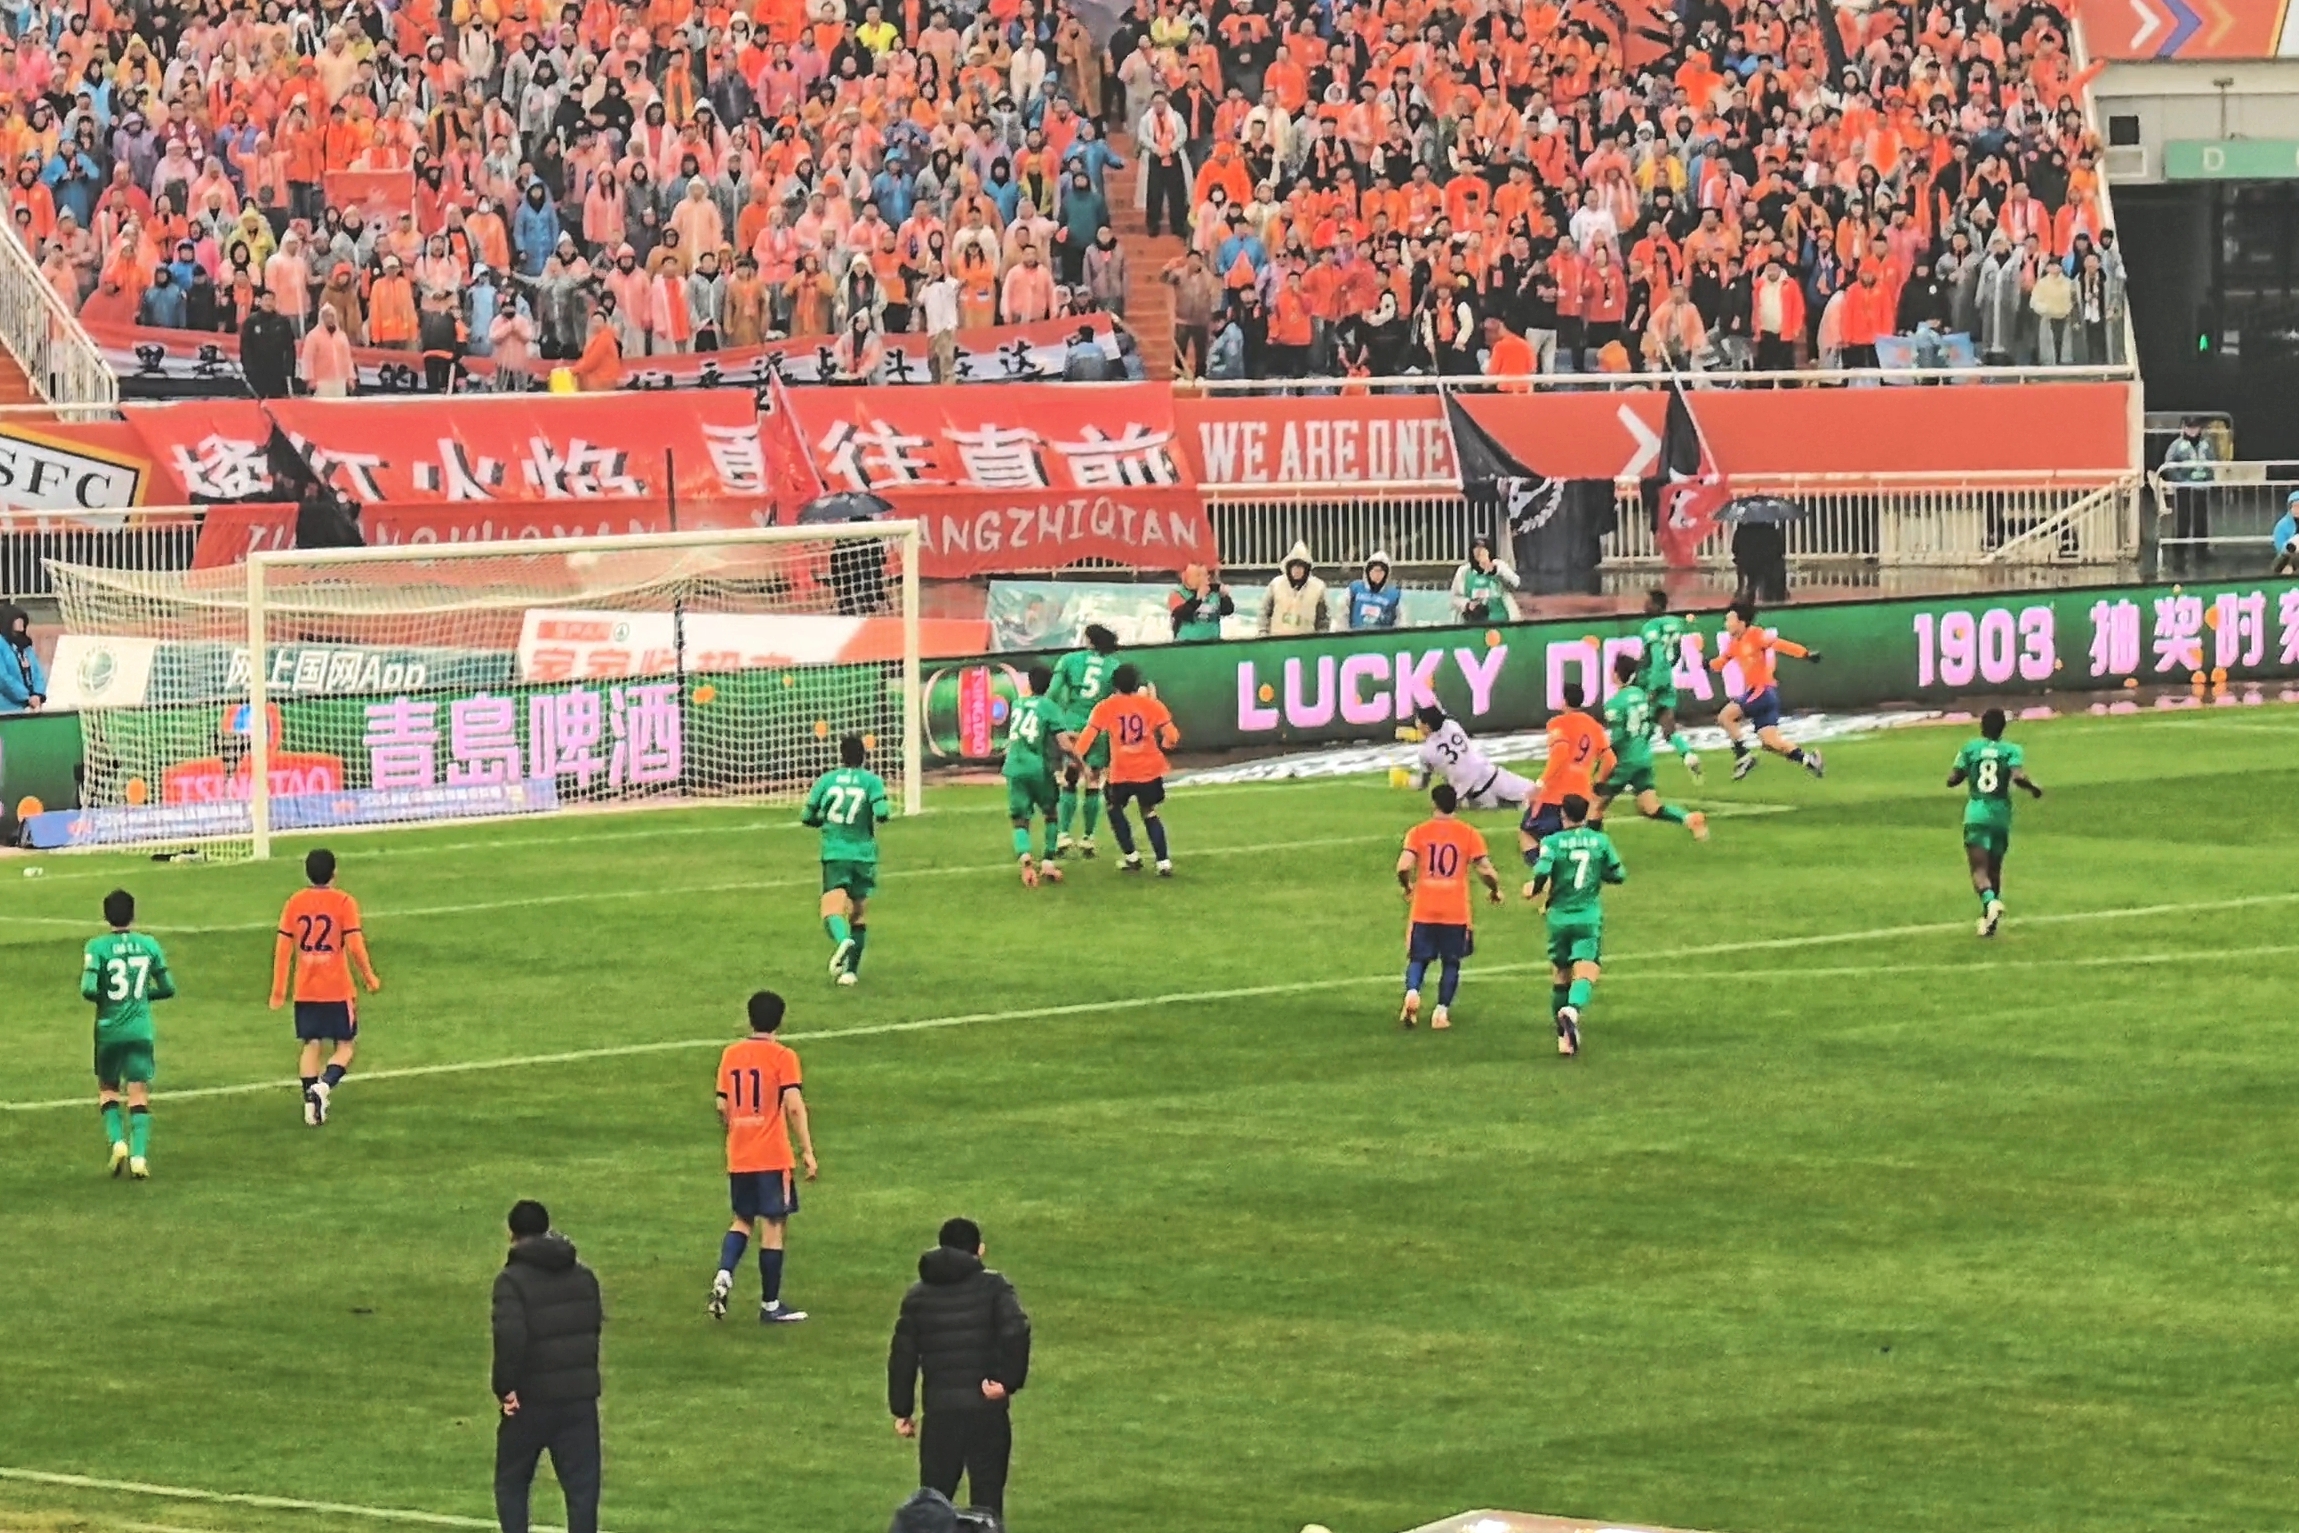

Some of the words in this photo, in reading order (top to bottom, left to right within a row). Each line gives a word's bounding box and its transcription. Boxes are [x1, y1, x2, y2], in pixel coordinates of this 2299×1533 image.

[2203, 146, 2225, 172] D
[1199, 421, 1268, 482] WE
[1277, 420, 1360, 481] ARE
[1366, 418, 1449, 480] ONE
[917, 497, 1200, 556] ANGZHIQIAN
[1079, 664, 1103, 699] 5
[1238, 645, 1508, 731] LUCKY
[1914, 606, 2055, 687] 1903
[362, 684, 681, 789] 青岛啤酒
[1009, 707, 1040, 744] 24
[1118, 713, 1144, 745] 19
[1436, 732, 1468, 765] 39
[1573, 733, 1591, 763] 9
[175, 766, 331, 805] TSINTAO
[1977, 759, 1998, 793] 8
[827, 786, 866, 824] 27
[1427, 842, 1458, 878] 10
[1569, 849, 1590, 890] 7
[297, 914, 333, 951] 22
[106, 955, 150, 1001] 37
[730, 1068, 760, 1113] 11
